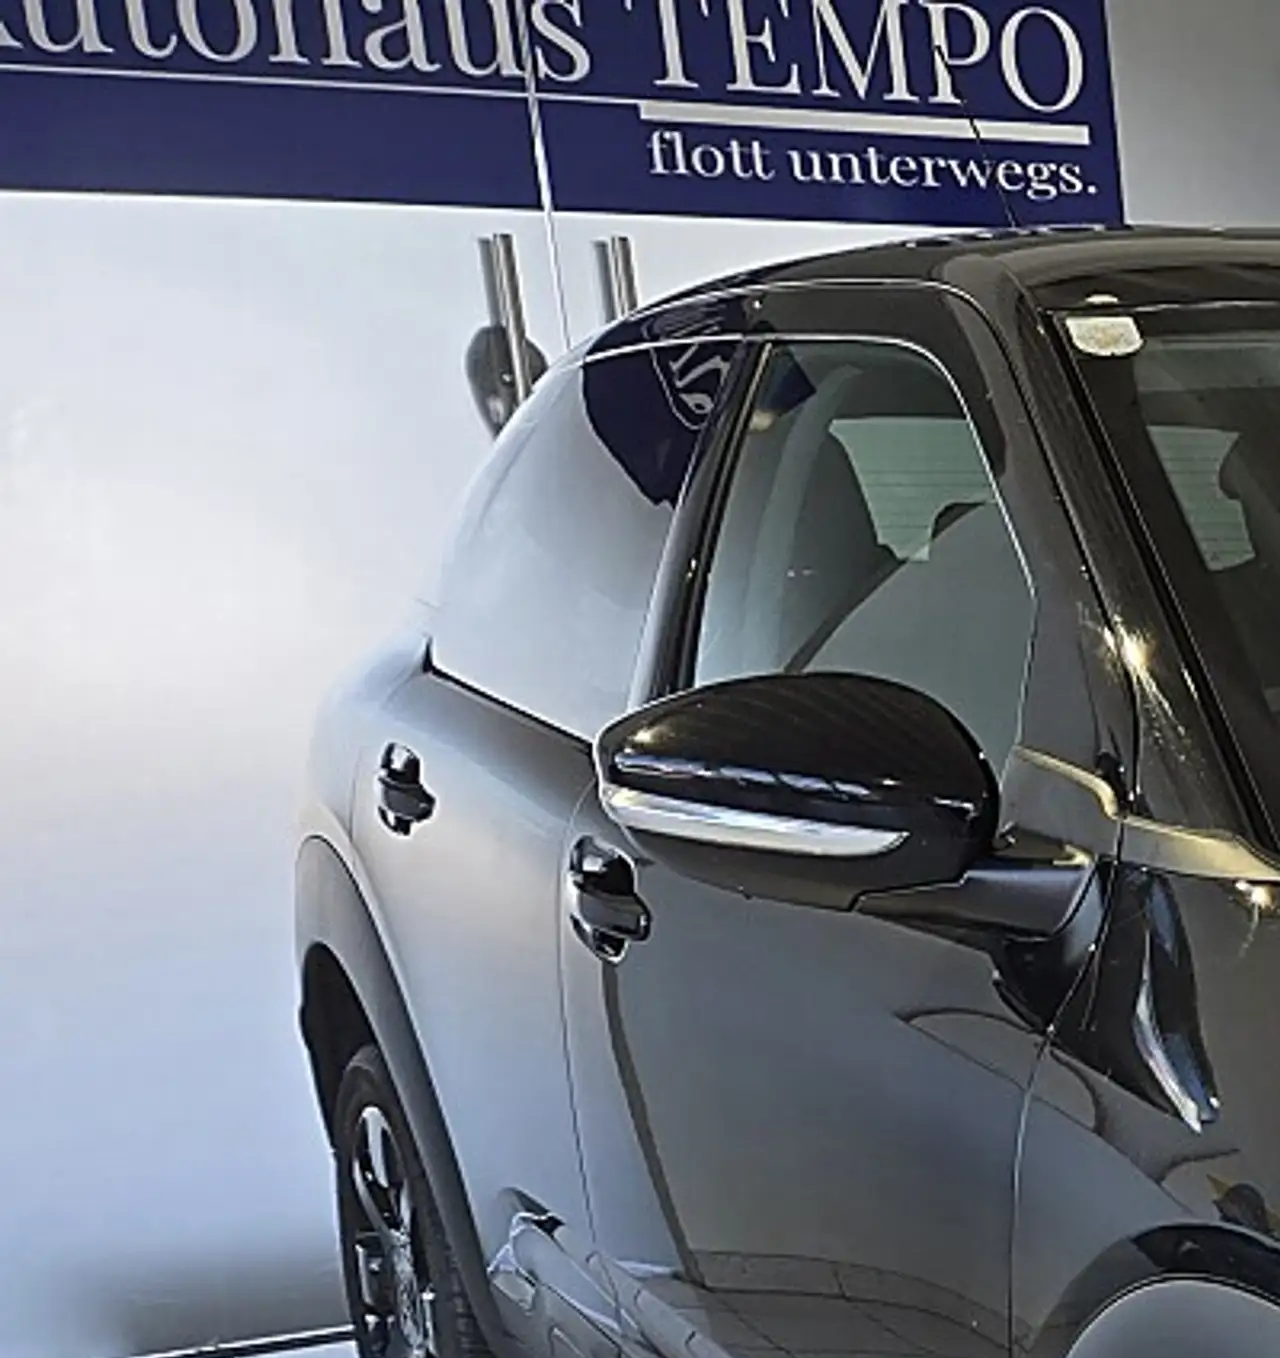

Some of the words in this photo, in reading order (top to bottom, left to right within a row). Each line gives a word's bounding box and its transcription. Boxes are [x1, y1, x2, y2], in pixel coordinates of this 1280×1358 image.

[612, 0, 1084, 112] TEMPO
[646, 130, 776, 180] flott
[786, 148, 1098, 200] unterwegs.
